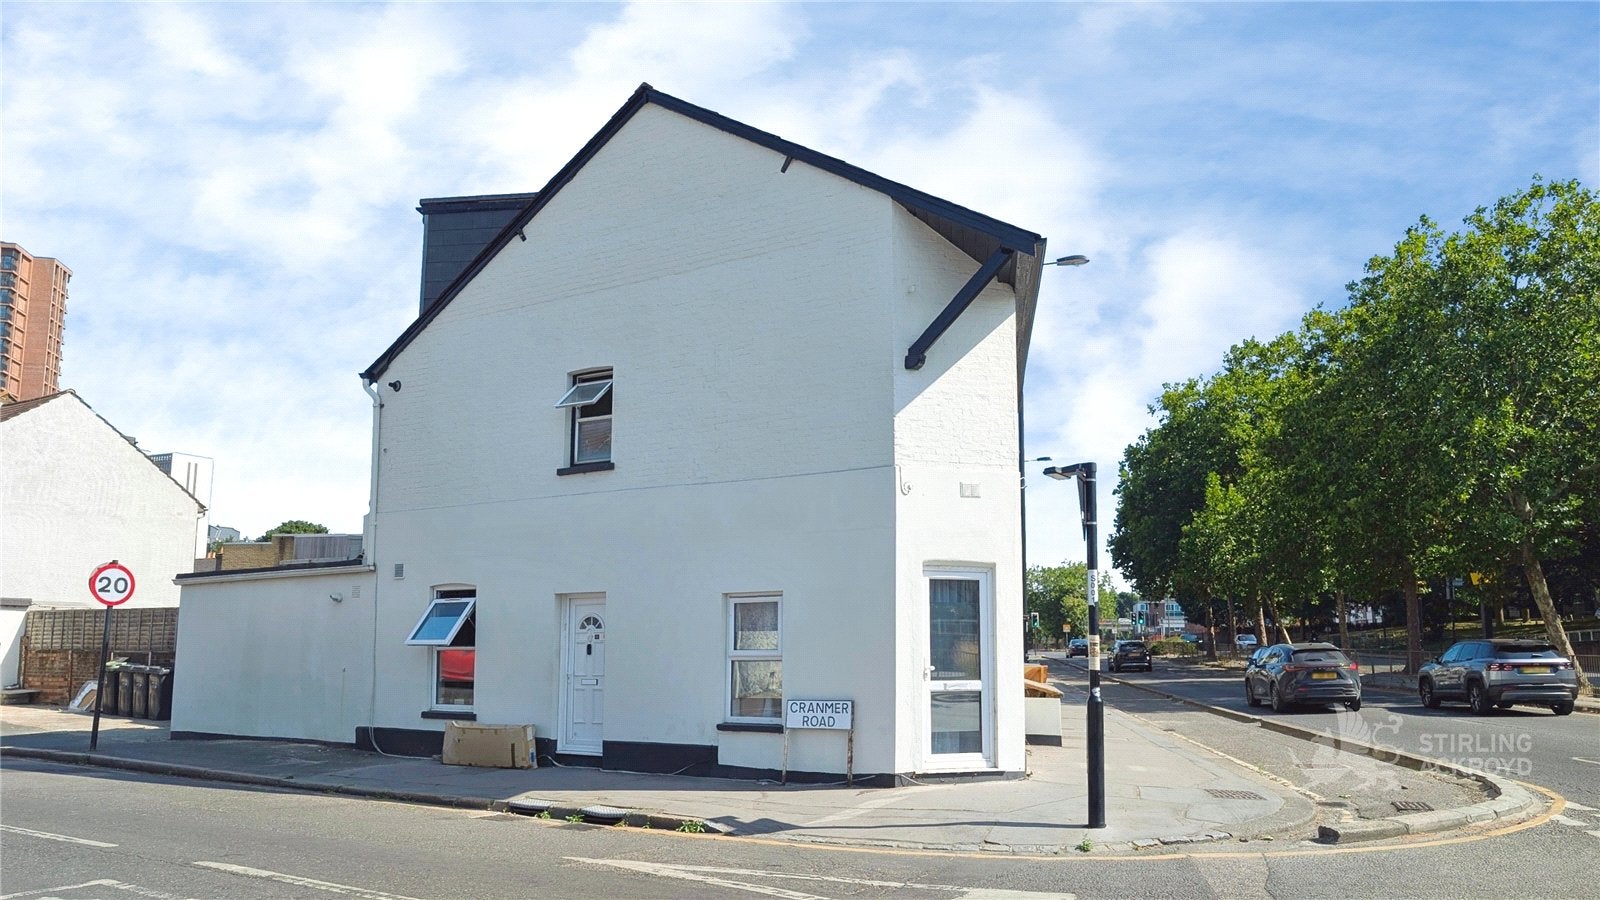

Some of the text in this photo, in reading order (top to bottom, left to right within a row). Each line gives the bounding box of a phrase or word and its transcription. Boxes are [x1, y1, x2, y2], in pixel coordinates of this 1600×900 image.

[98, 576, 129, 594] 20
[790, 702, 849, 714] CRANMER
[802, 716, 836, 727] ROAD
